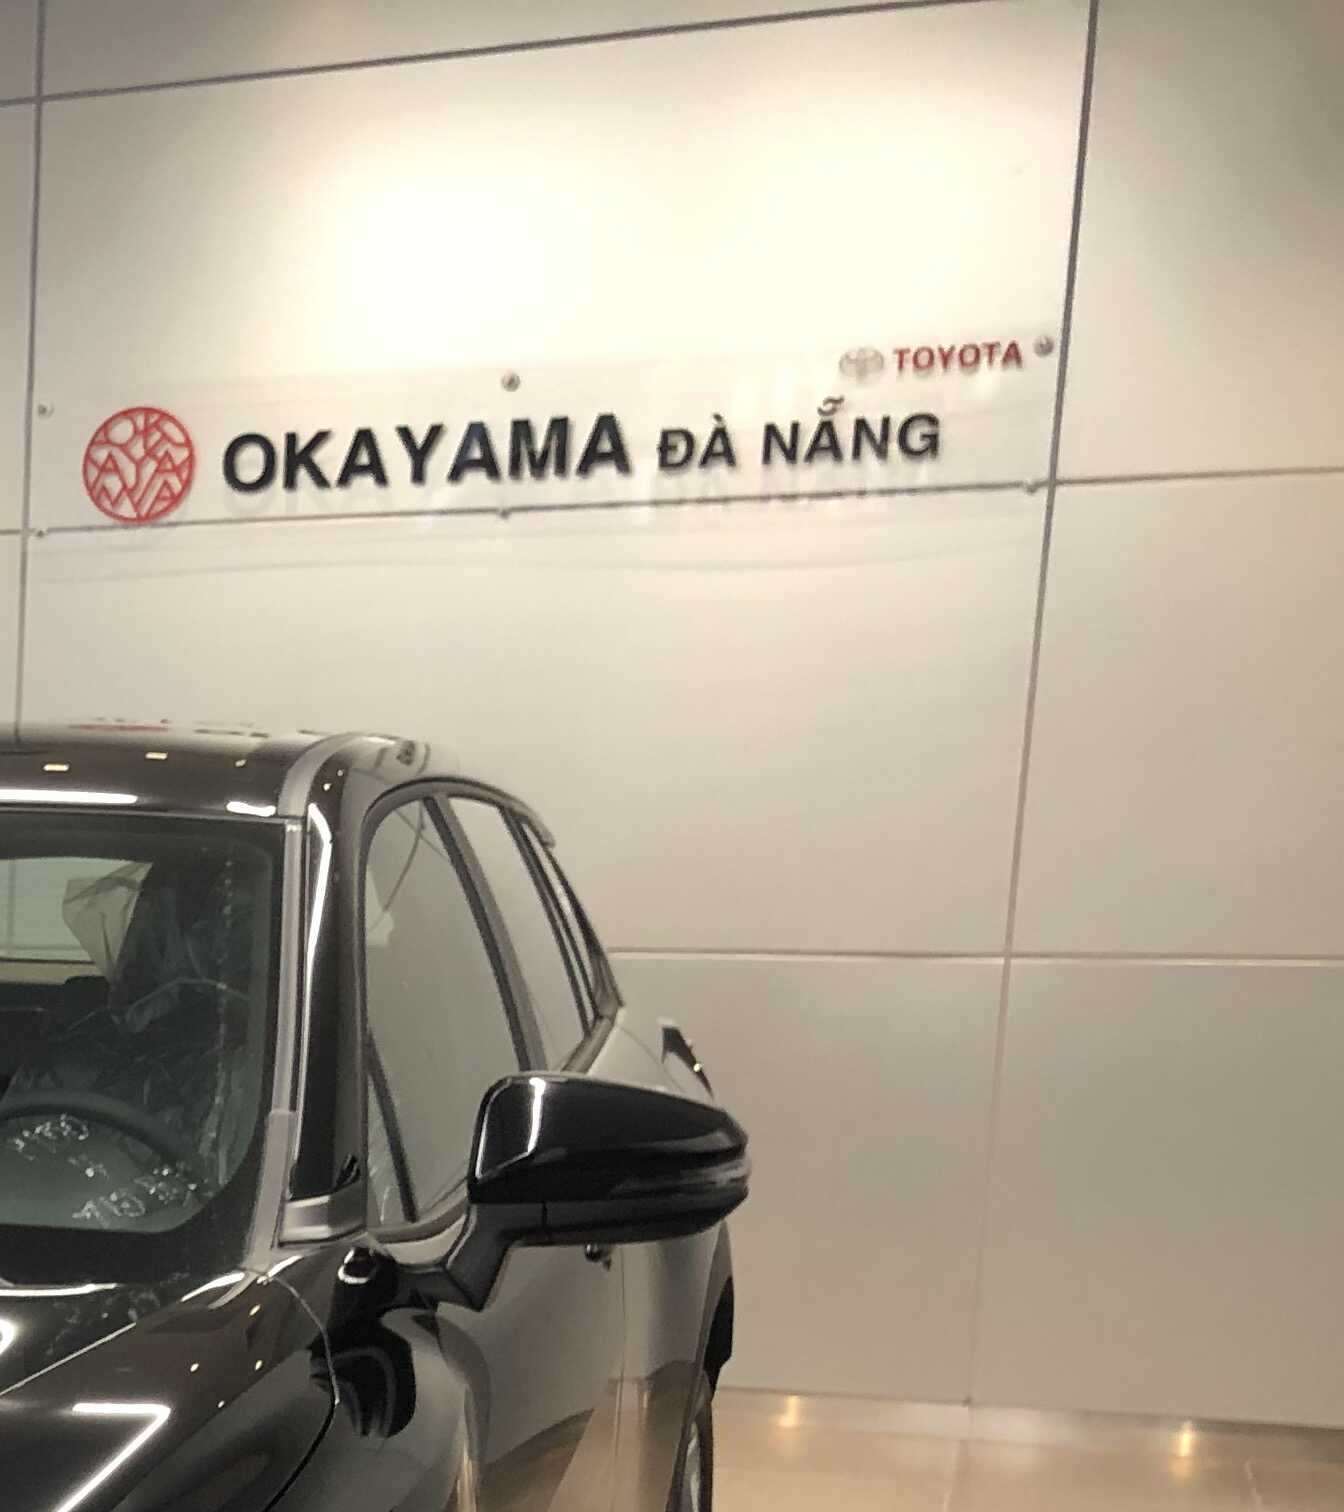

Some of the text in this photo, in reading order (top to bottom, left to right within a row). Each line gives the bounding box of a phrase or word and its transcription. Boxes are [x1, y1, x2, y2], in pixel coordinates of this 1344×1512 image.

[893, 339, 1023, 374] TOYOTA
[223, 396, 940, 493] OKAYAMA ĐÀ NẴNG
